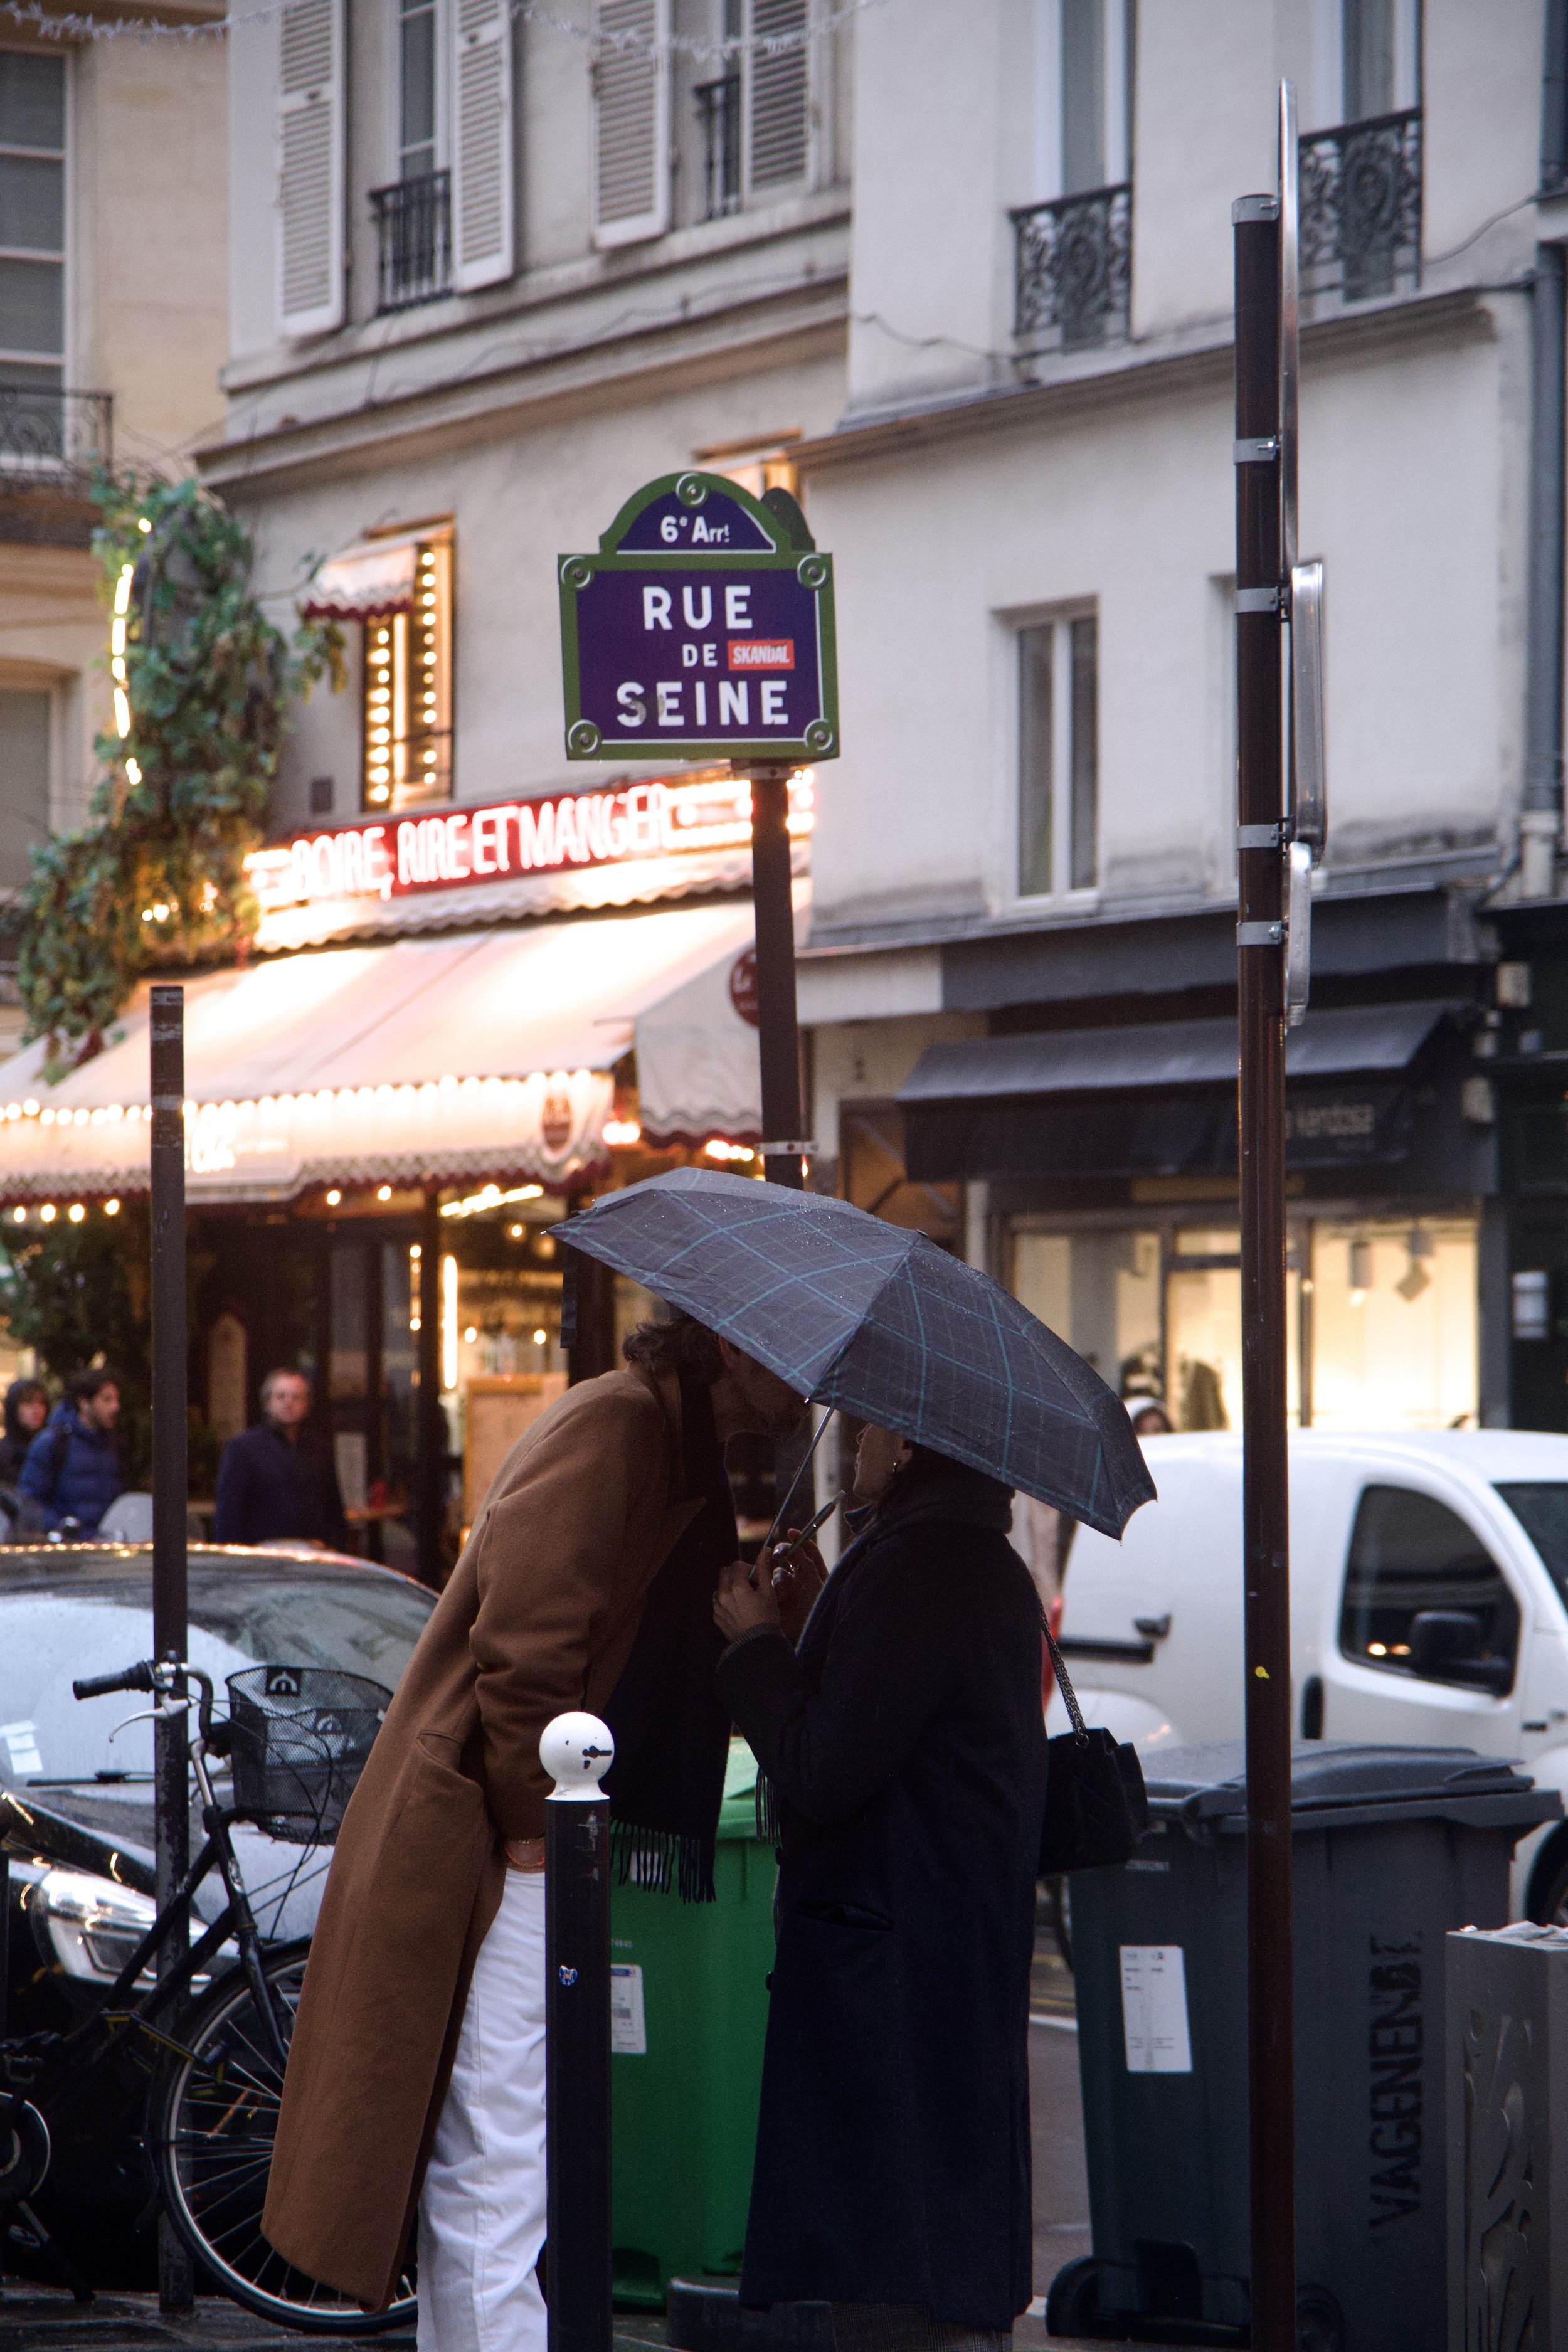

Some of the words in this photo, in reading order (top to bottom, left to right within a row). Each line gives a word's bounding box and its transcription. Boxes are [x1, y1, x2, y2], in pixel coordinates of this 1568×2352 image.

[642, 585, 753, 630] RUE
[682, 643, 718, 667] DE
[733, 644, 790, 665] SKANDAL
[616, 680, 789, 728] SEINE
[397, 814, 471, 886] RIRE
[472, 805, 521, 875] ET
[518, 782, 670, 869] MANGER
